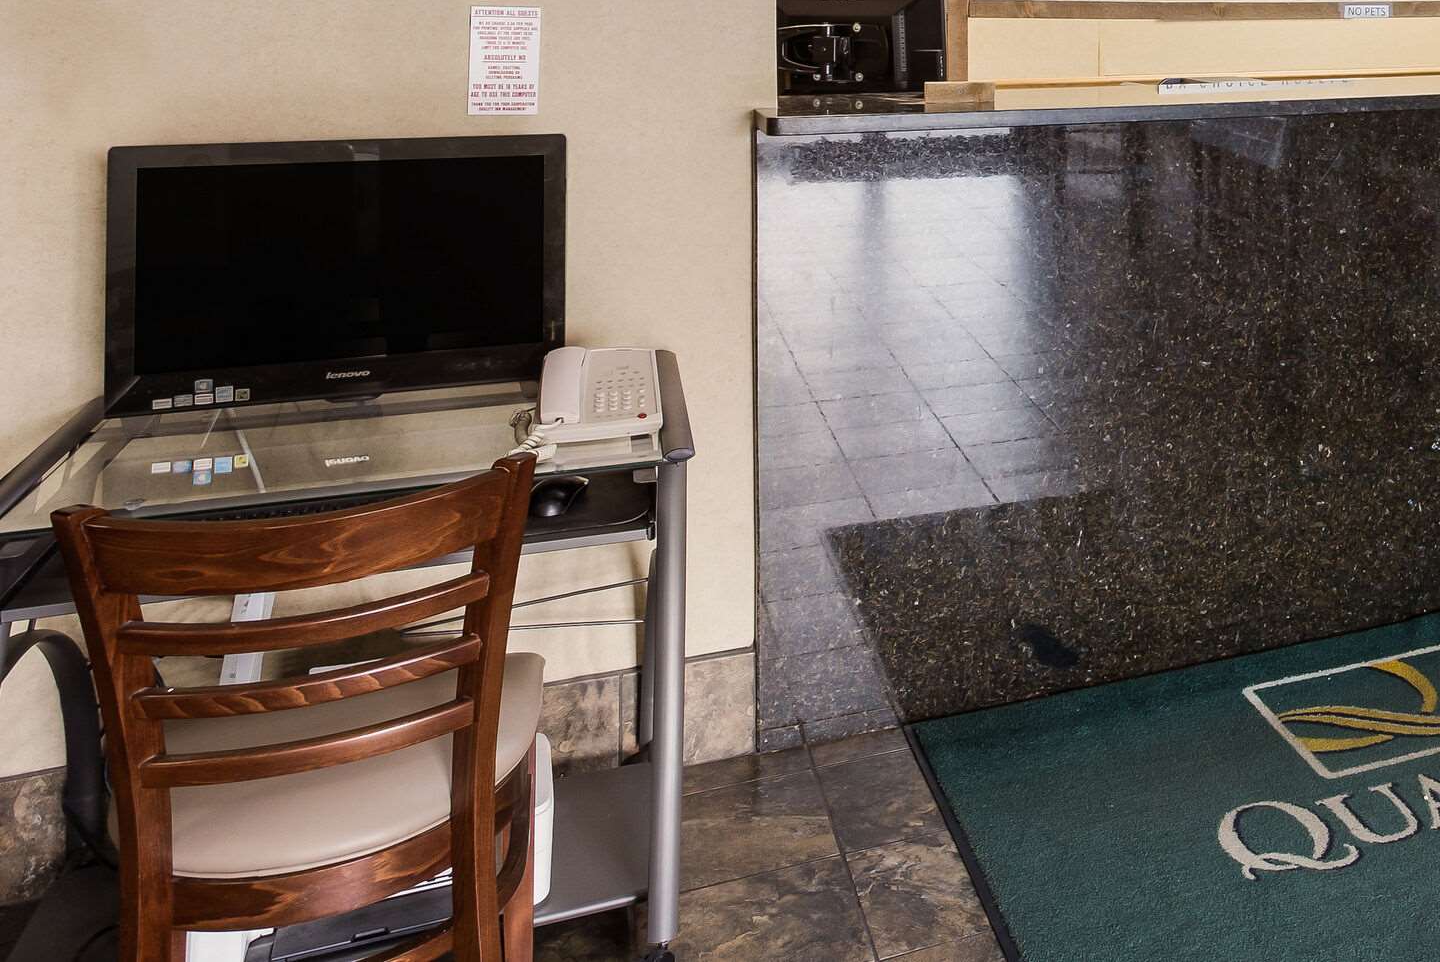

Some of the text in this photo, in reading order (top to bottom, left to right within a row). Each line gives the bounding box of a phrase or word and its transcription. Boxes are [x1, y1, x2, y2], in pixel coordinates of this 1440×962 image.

[1348, 7, 1386, 16] NO PETS
[326, 369, 370, 380] lenovo
